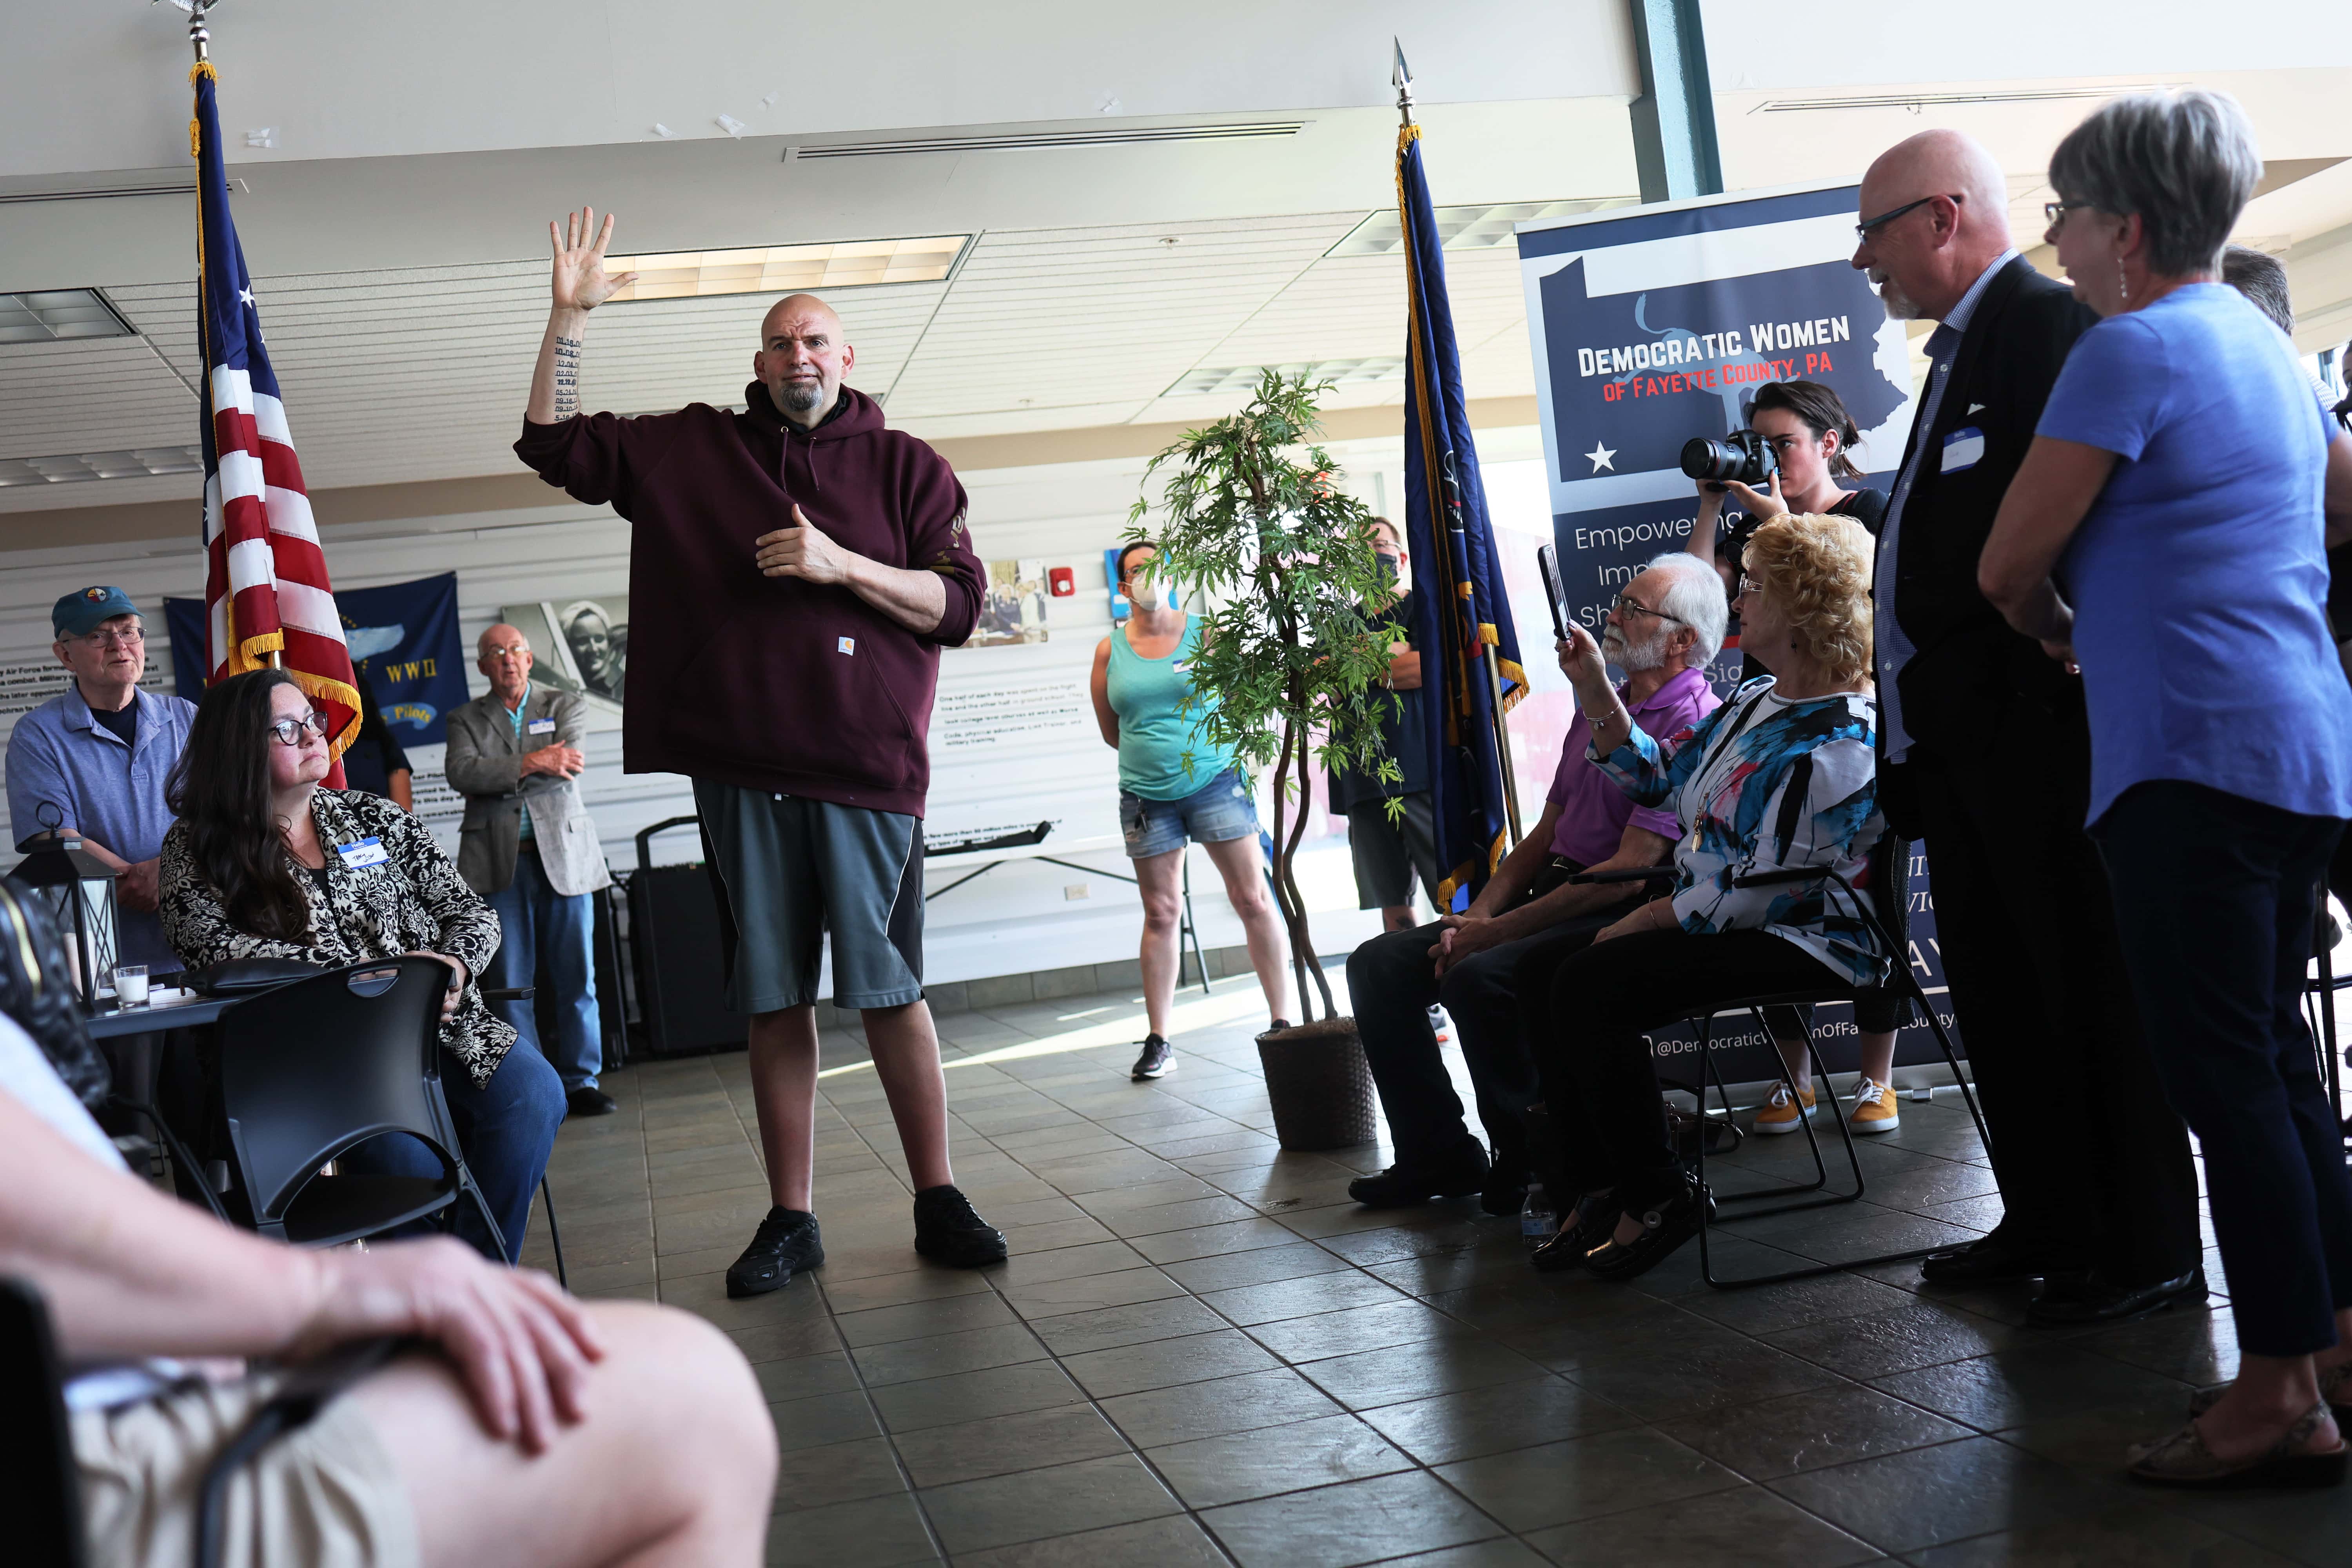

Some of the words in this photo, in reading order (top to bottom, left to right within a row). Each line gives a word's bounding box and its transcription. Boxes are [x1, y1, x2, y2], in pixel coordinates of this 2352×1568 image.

[1578, 330, 1743, 377] DEMOCRATIC
[1749, 315, 1850, 353] WOMEN
[1633, 368, 1717, 397] FAYETTE
[1805, 351, 1833, 374] PA
